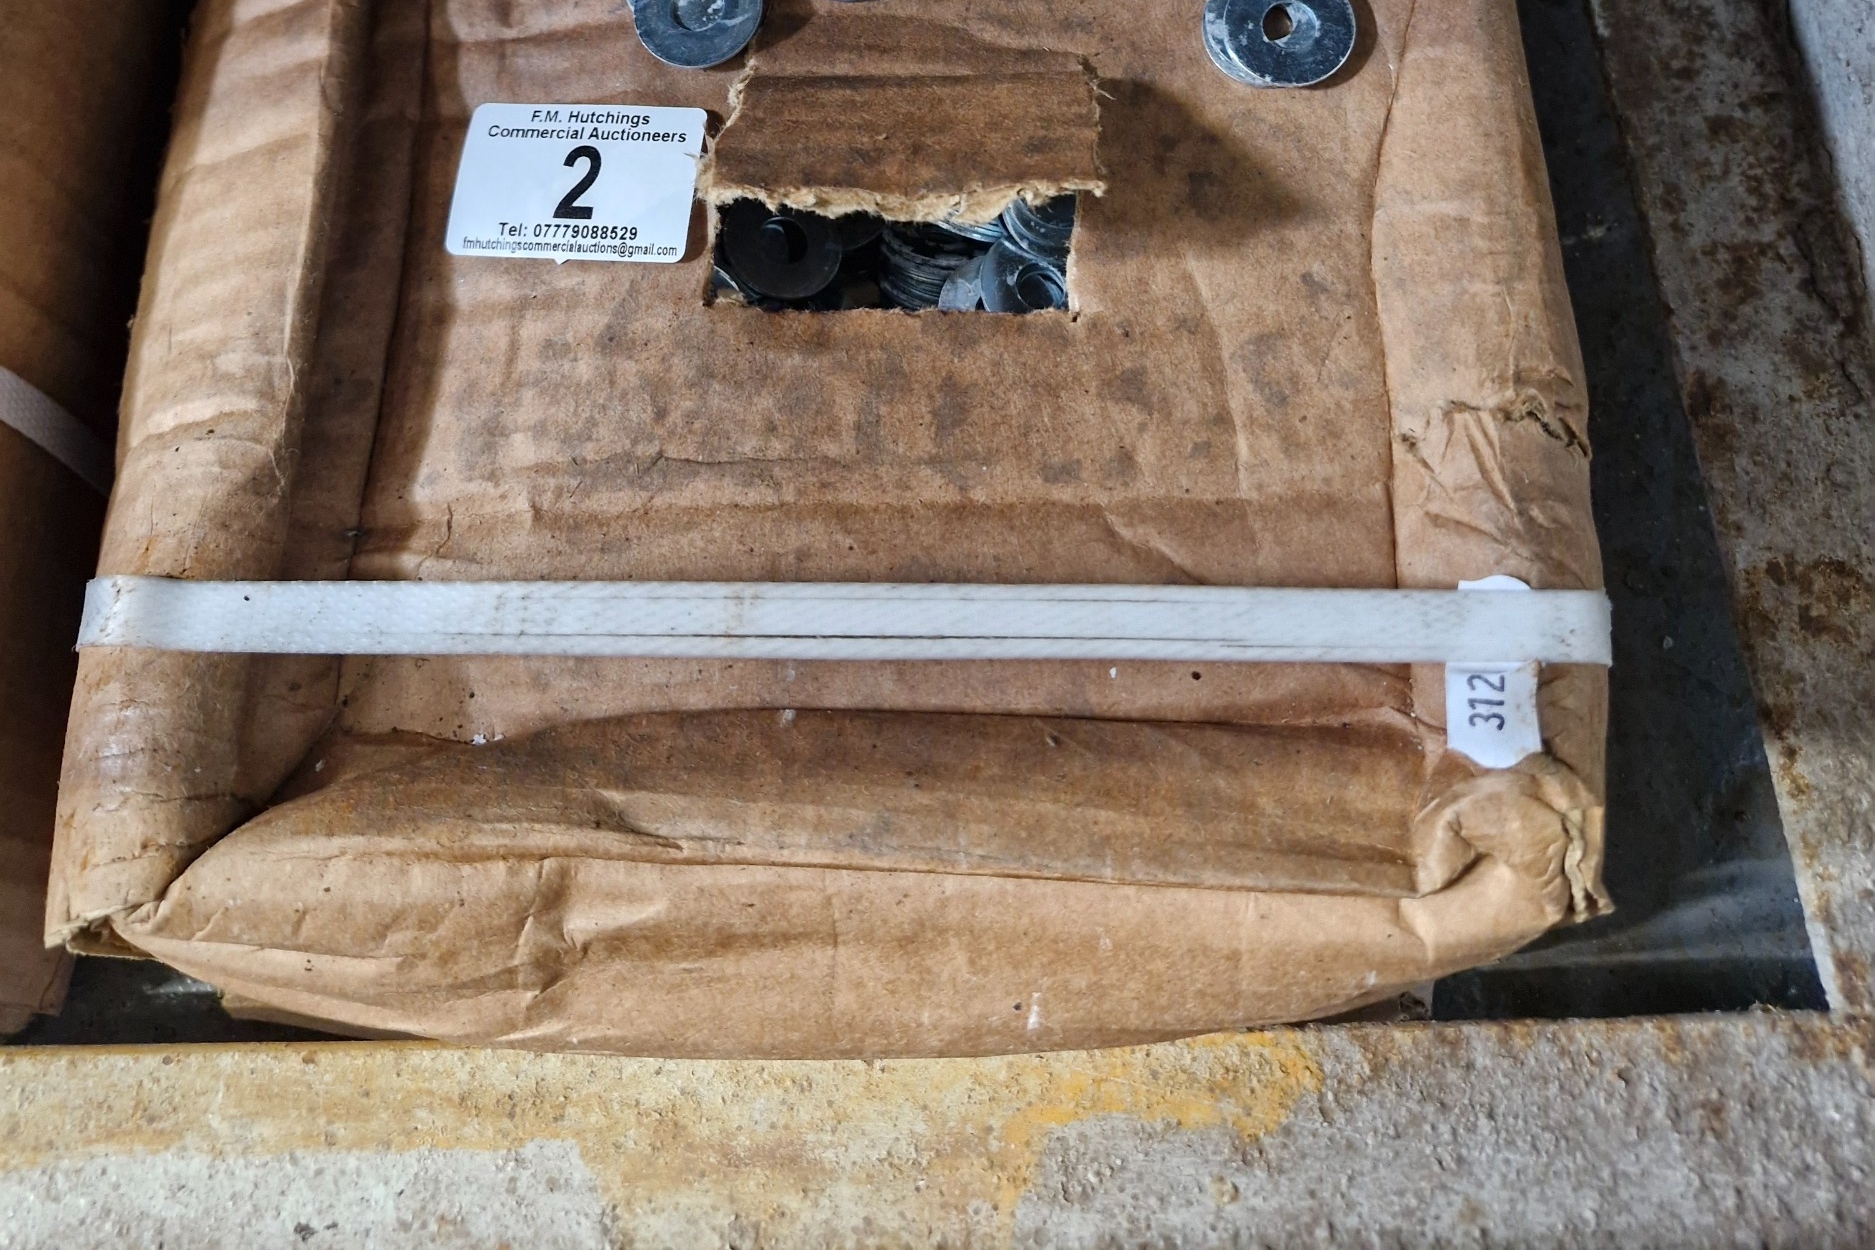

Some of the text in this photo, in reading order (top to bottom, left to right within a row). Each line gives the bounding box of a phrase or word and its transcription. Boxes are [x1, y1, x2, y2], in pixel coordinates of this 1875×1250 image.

[530, 110, 651, 128] F.M. Hutchings
[488, 125, 687, 143] Commercial Auctioneers
[552, 145, 602, 220] 2
[499, 222, 638, 241] Tel: 07779088529
[462, 236, 677, 258] fmhutchingscommercialauctions@gmail.com
[1466, 674, 1505, 731] 312
